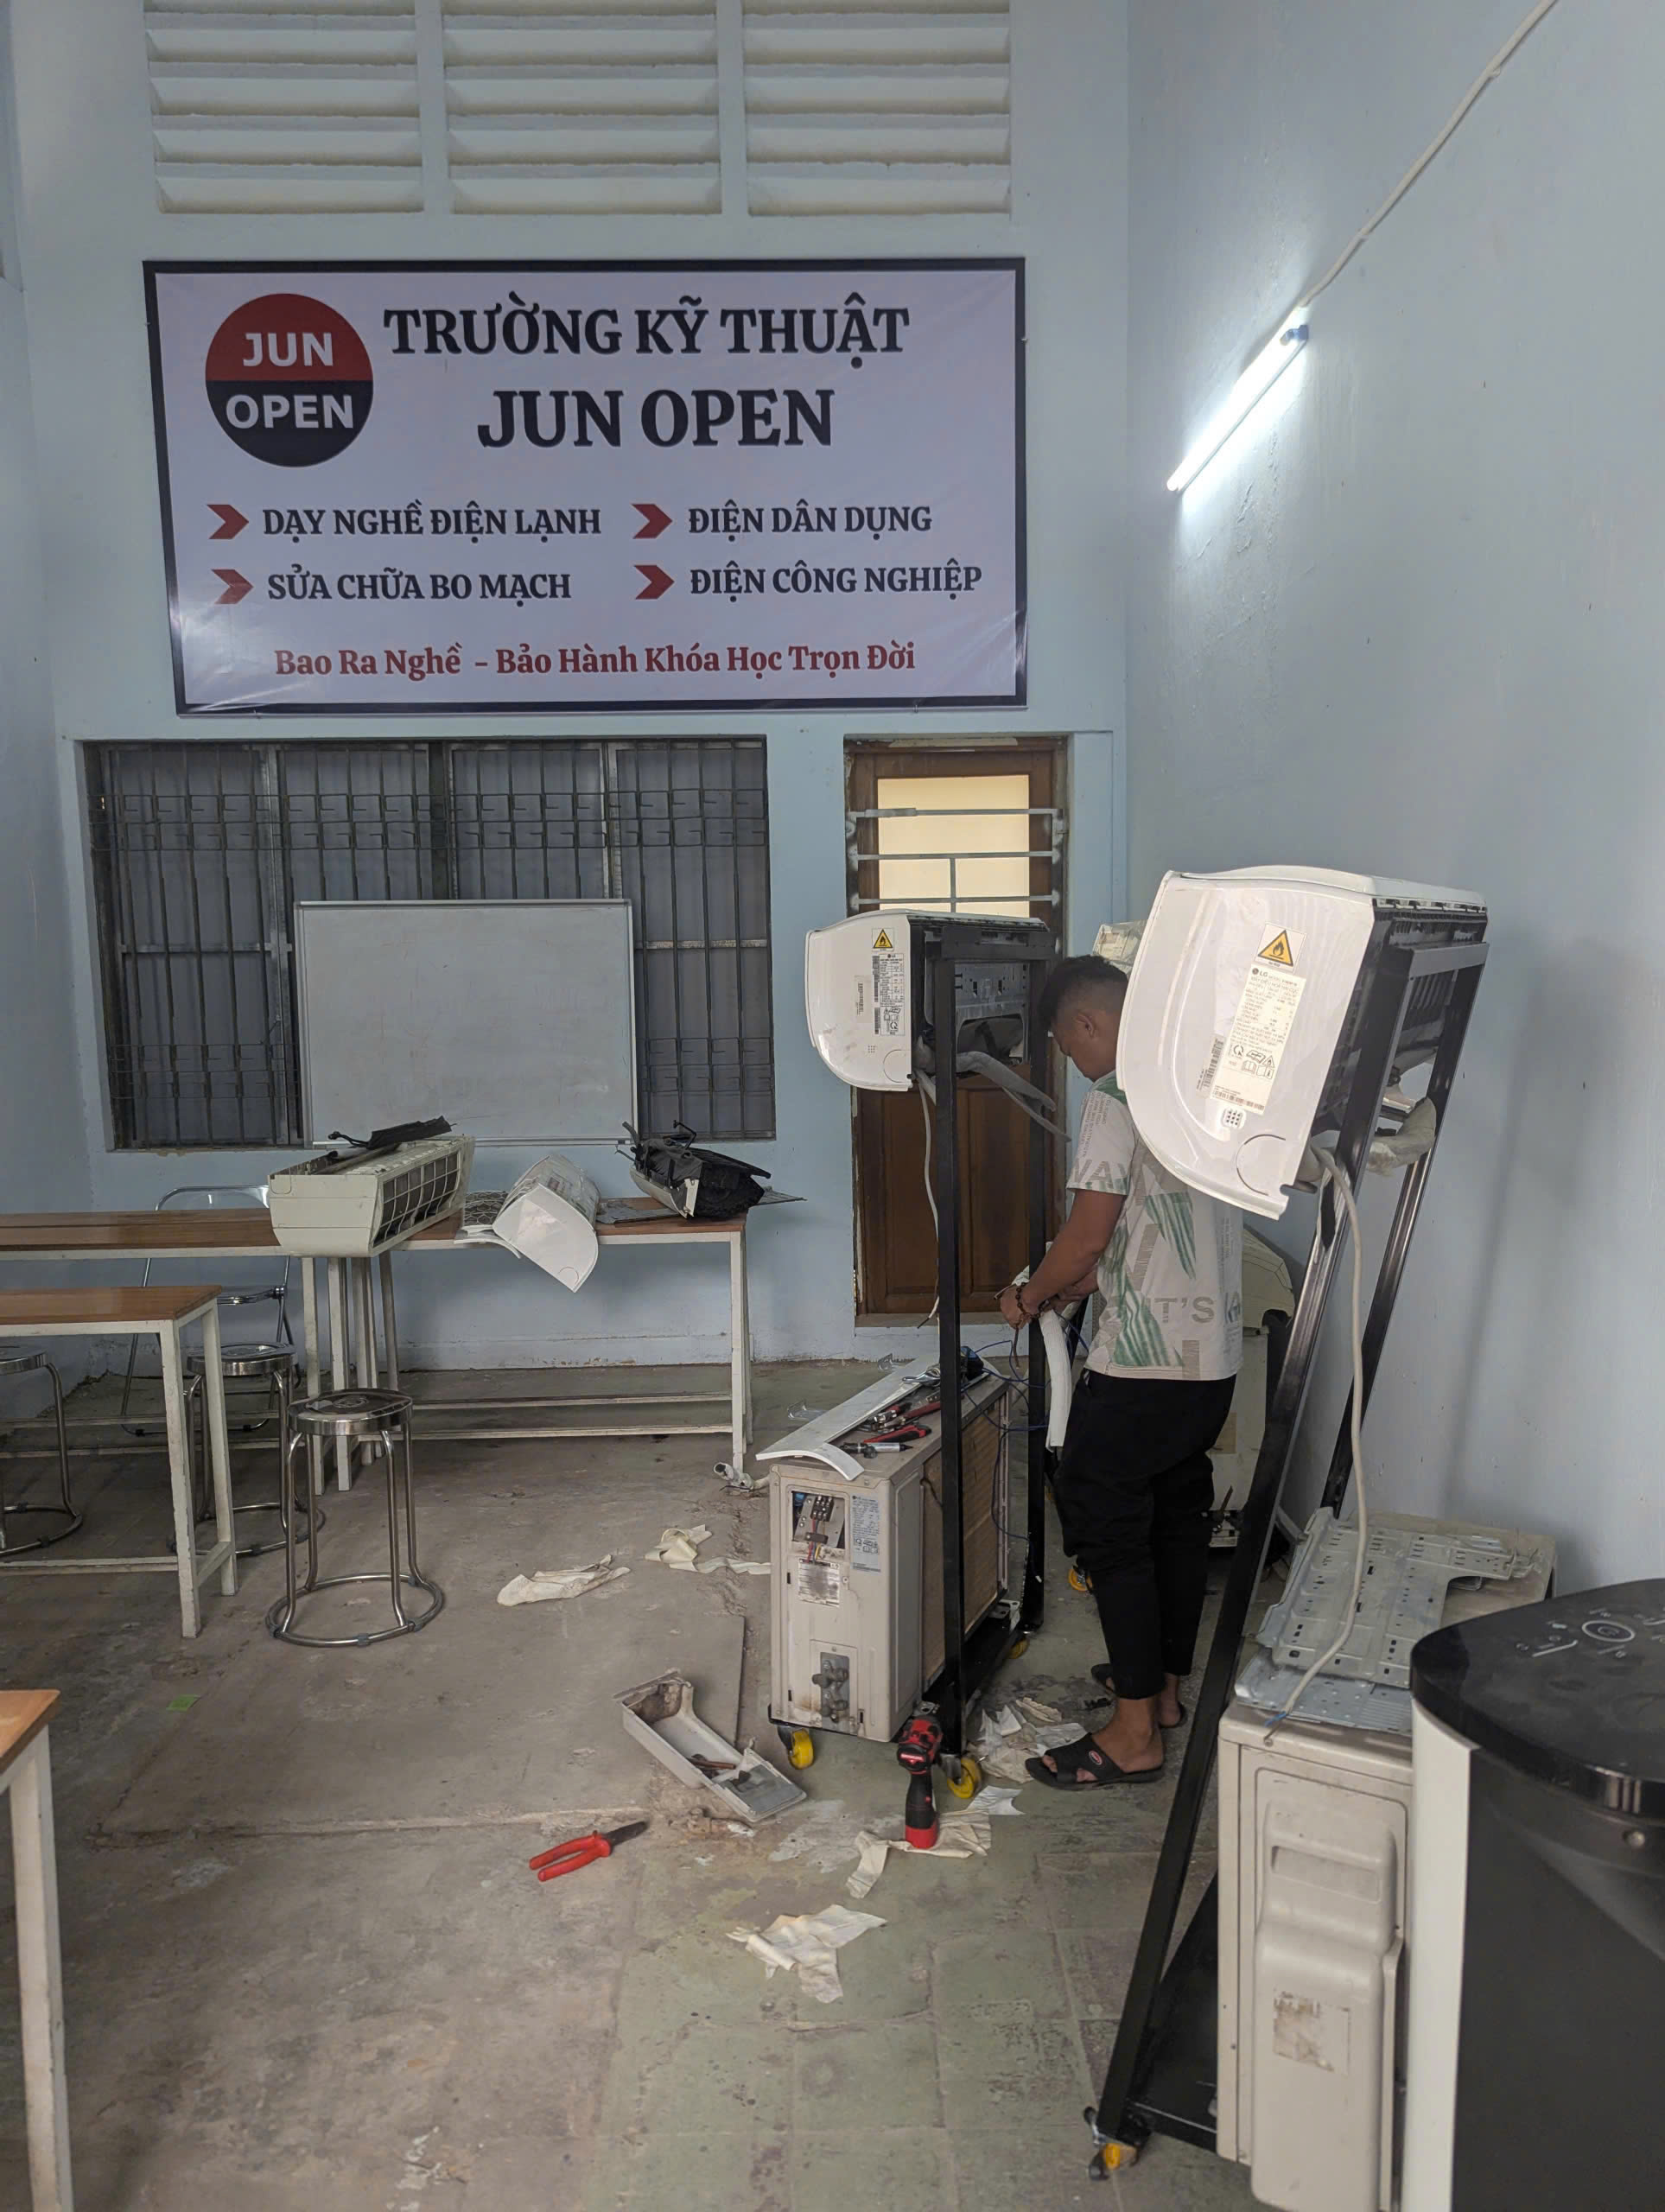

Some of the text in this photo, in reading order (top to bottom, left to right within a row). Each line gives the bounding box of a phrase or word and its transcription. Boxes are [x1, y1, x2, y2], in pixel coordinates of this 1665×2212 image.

[243, 332, 334, 367] JUN
[383, 290, 910, 369] TRƯỜNG KỸ THUẬT
[226, 394, 353, 429] OPEN
[477, 388, 836, 448] JUN OPEN
[263, 499, 602, 543] DẠY NGHỀ ĐIỆN LẠNH
[688, 498, 933, 543] ĐIỆN DÂN DỤNG
[268, 563, 572, 607] SỬA CHỮA BO MẠCH
[690, 557, 982, 603] ĐIỆN CÔNG NGHIỆP
[274, 650, 333, 676] Bao
[338, 649, 378, 675] Ra
[384, 641, 463, 682] Nghề
[495, 643, 552, 674] Bảo
[557, 643, 639, 673] Hành
[644, 642, 721, 673] Khóa
[726, 646, 783, 680] Học
[787, 645, 861, 679] Trọn
[867, 639, 916, 671] Đời
